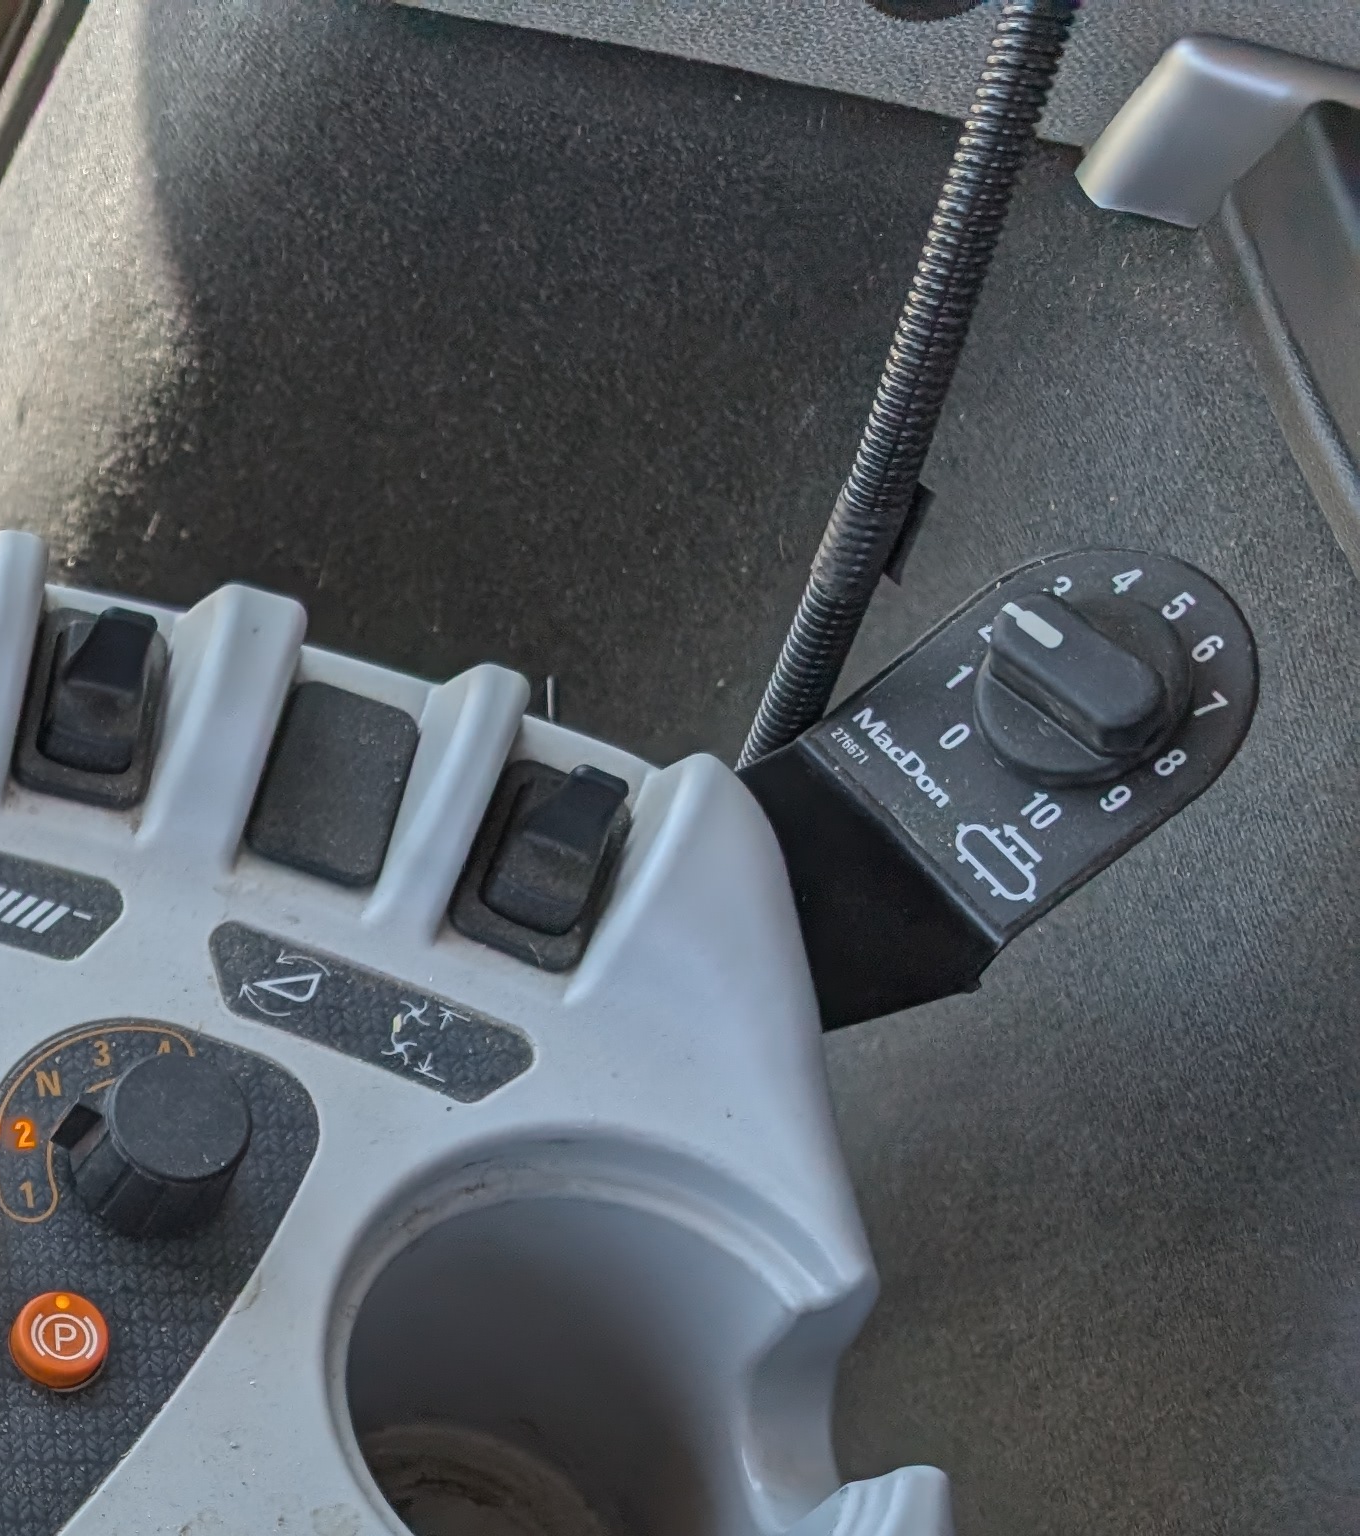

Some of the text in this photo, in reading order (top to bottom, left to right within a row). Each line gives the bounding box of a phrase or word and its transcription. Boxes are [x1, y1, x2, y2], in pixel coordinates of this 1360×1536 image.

[1111, 568, 1143, 595] 4
[1161, 591, 1196, 620] 5
[1191, 635, 1224, 663] 6
[946, 664, 974, 690] 1
[1193, 689, 1229, 717] 7
[830, 727, 869, 765] 276671
[939, 723, 970, 750] 0
[852, 707, 949, 808] MacDon
[1154, 749, 1187, 777] 8
[1020, 791, 1062, 830] 10
[1099, 785, 1132, 812] 9
[93, 1040, 111, 1067] 3
[35, 1070, 61, 1098] N
[13, 1120, 35, 1149] 2
[18, 1181, 34, 1208] 1
[54, 1323, 77, 1351] P
